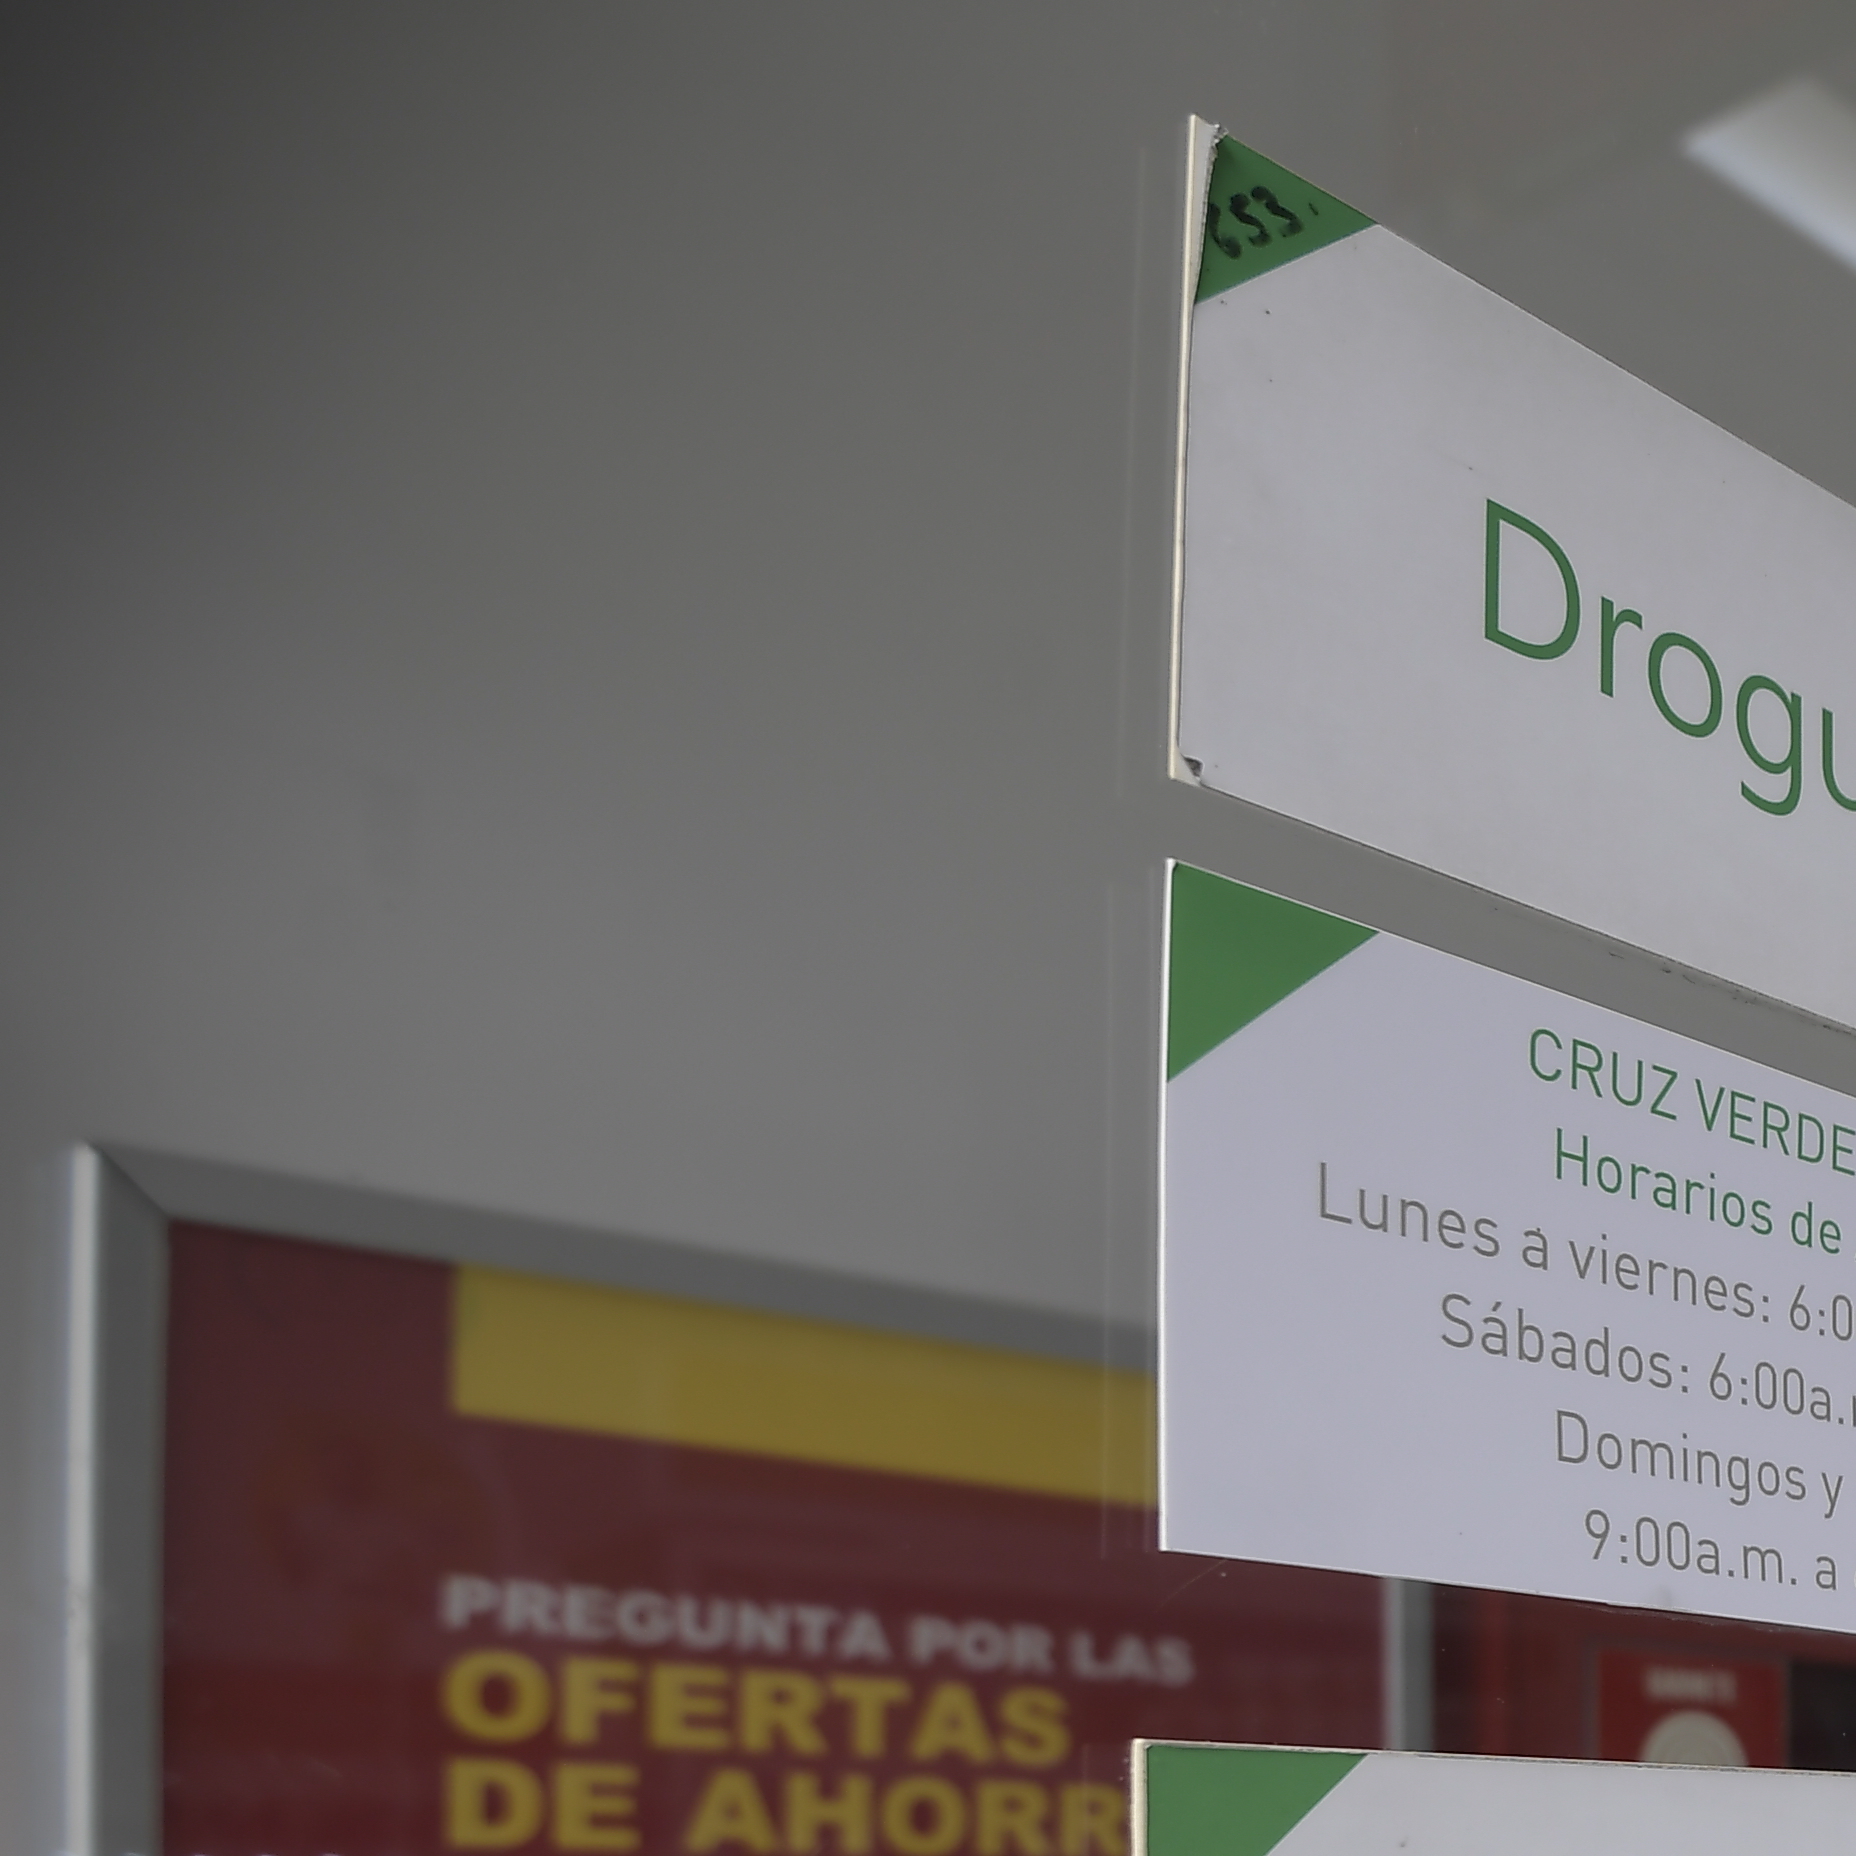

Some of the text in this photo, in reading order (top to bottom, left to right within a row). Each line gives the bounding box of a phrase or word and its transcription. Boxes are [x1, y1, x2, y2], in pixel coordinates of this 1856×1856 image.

[1528, 1028, 1679, 1120] CRUZ
[1695, 1078, 1856, 1177] VERDE
[1319, 1161, 1500, 1258] Lunes
[1521, 1229, 1549, 1271] a
[1568, 1233, 1771, 1323] viernes:
[1555, 1127, 1773, 1236] Horarios
[1790, 1200, 1842, 1254] de
[1440, 1292, 1690, 1394] Sábados:
[1556, 1409, 1807, 1507] Domingos
[1821, 1469, 1844, 1520] y
[1584, 1508, 1797, 1587] 9:00a.m.
[1814, 1551, 1838, 1592] a
[441, 1576, 1193, 1688] PREGUNTA POR LAS
[443, 1648, 1073, 1768] OFERTAS
[443, 1756, 643, 1852] DE
